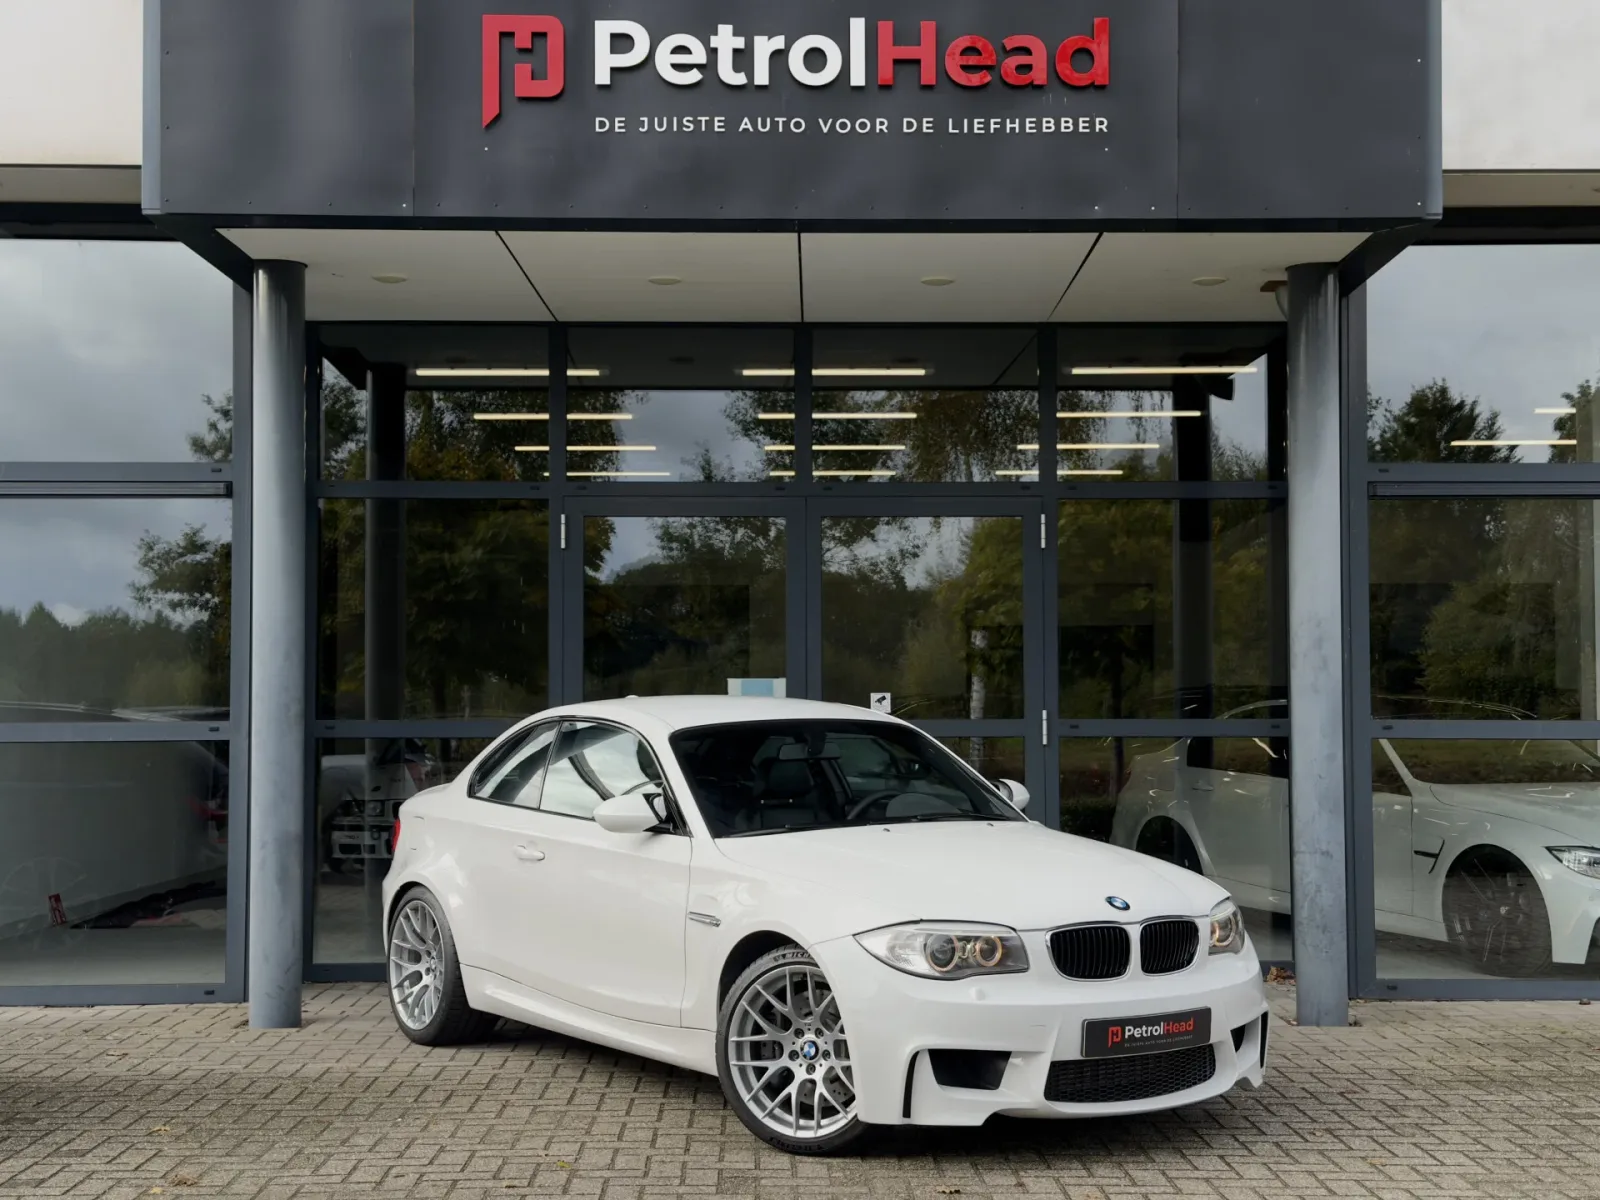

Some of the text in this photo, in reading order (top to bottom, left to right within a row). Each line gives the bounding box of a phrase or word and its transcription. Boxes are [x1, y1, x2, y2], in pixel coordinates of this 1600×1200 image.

[594, 17, 1111, 87] PetrolHead
[595, 117, 1109, 133] DE JUISTE AUTO VOOR DE LIEFHEBBER
[1125, 1017, 1194, 1038] PetrolHead
